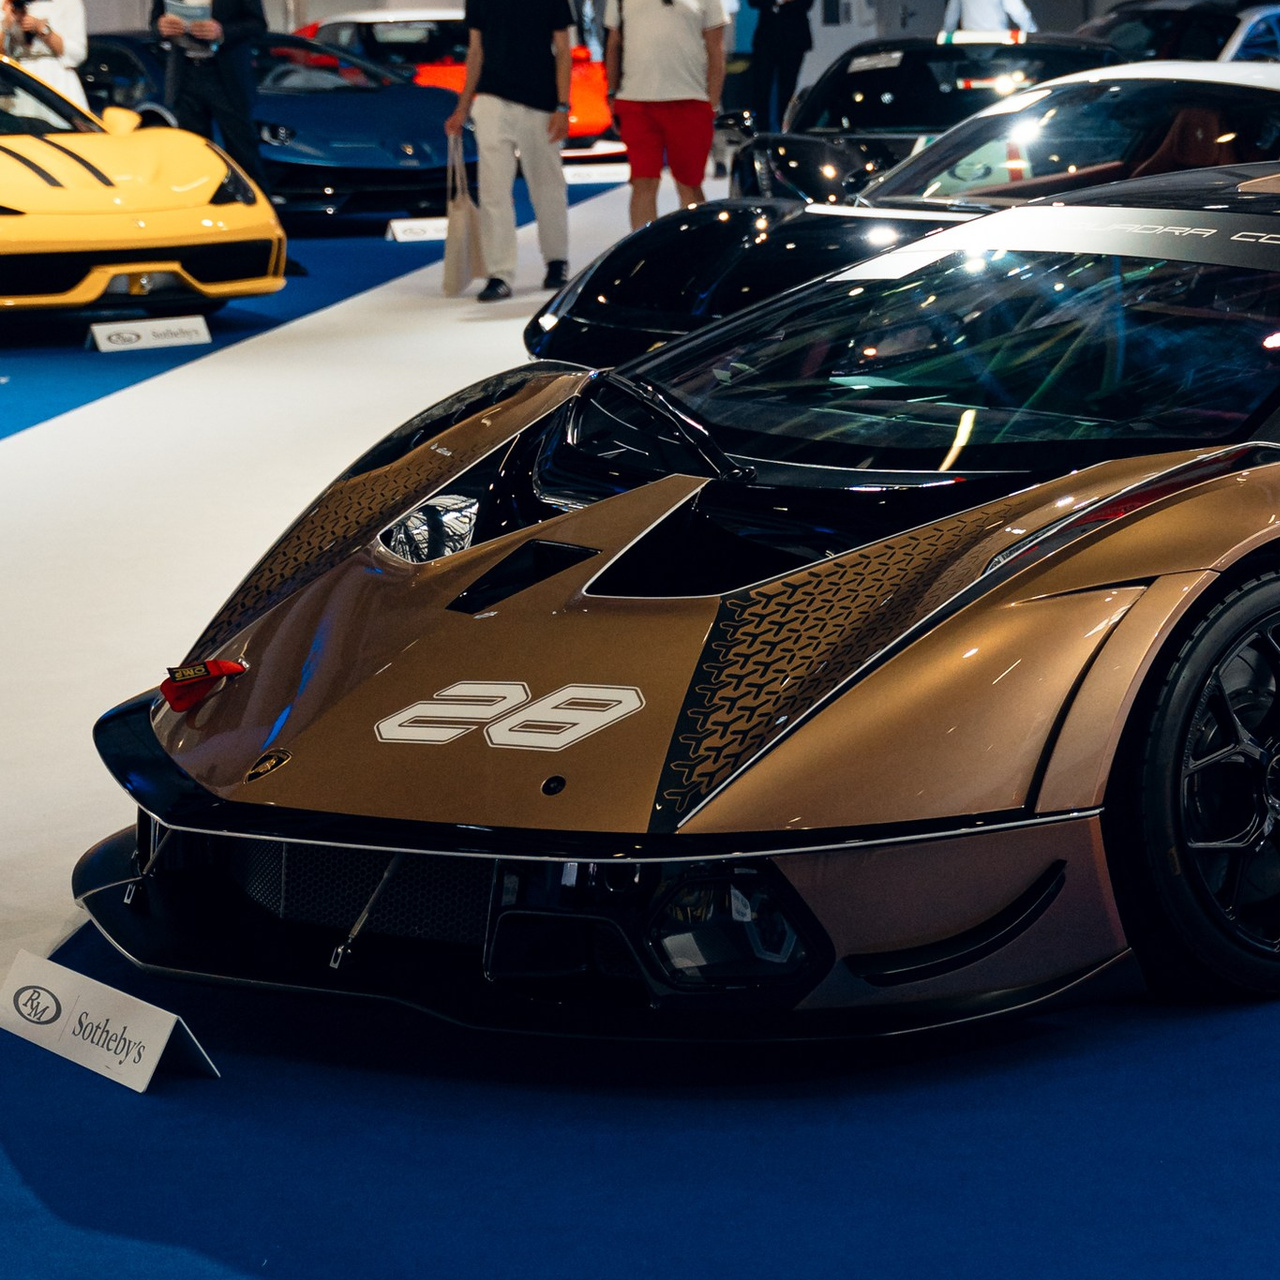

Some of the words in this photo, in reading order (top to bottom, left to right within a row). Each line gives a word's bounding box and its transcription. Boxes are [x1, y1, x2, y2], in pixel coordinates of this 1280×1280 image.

[174, 666, 206, 679] OMP
[374, 681, 646, 752] 28
[22, 989, 50, 1021] RM
[72, 1011, 146, 1066] Sotheby's
